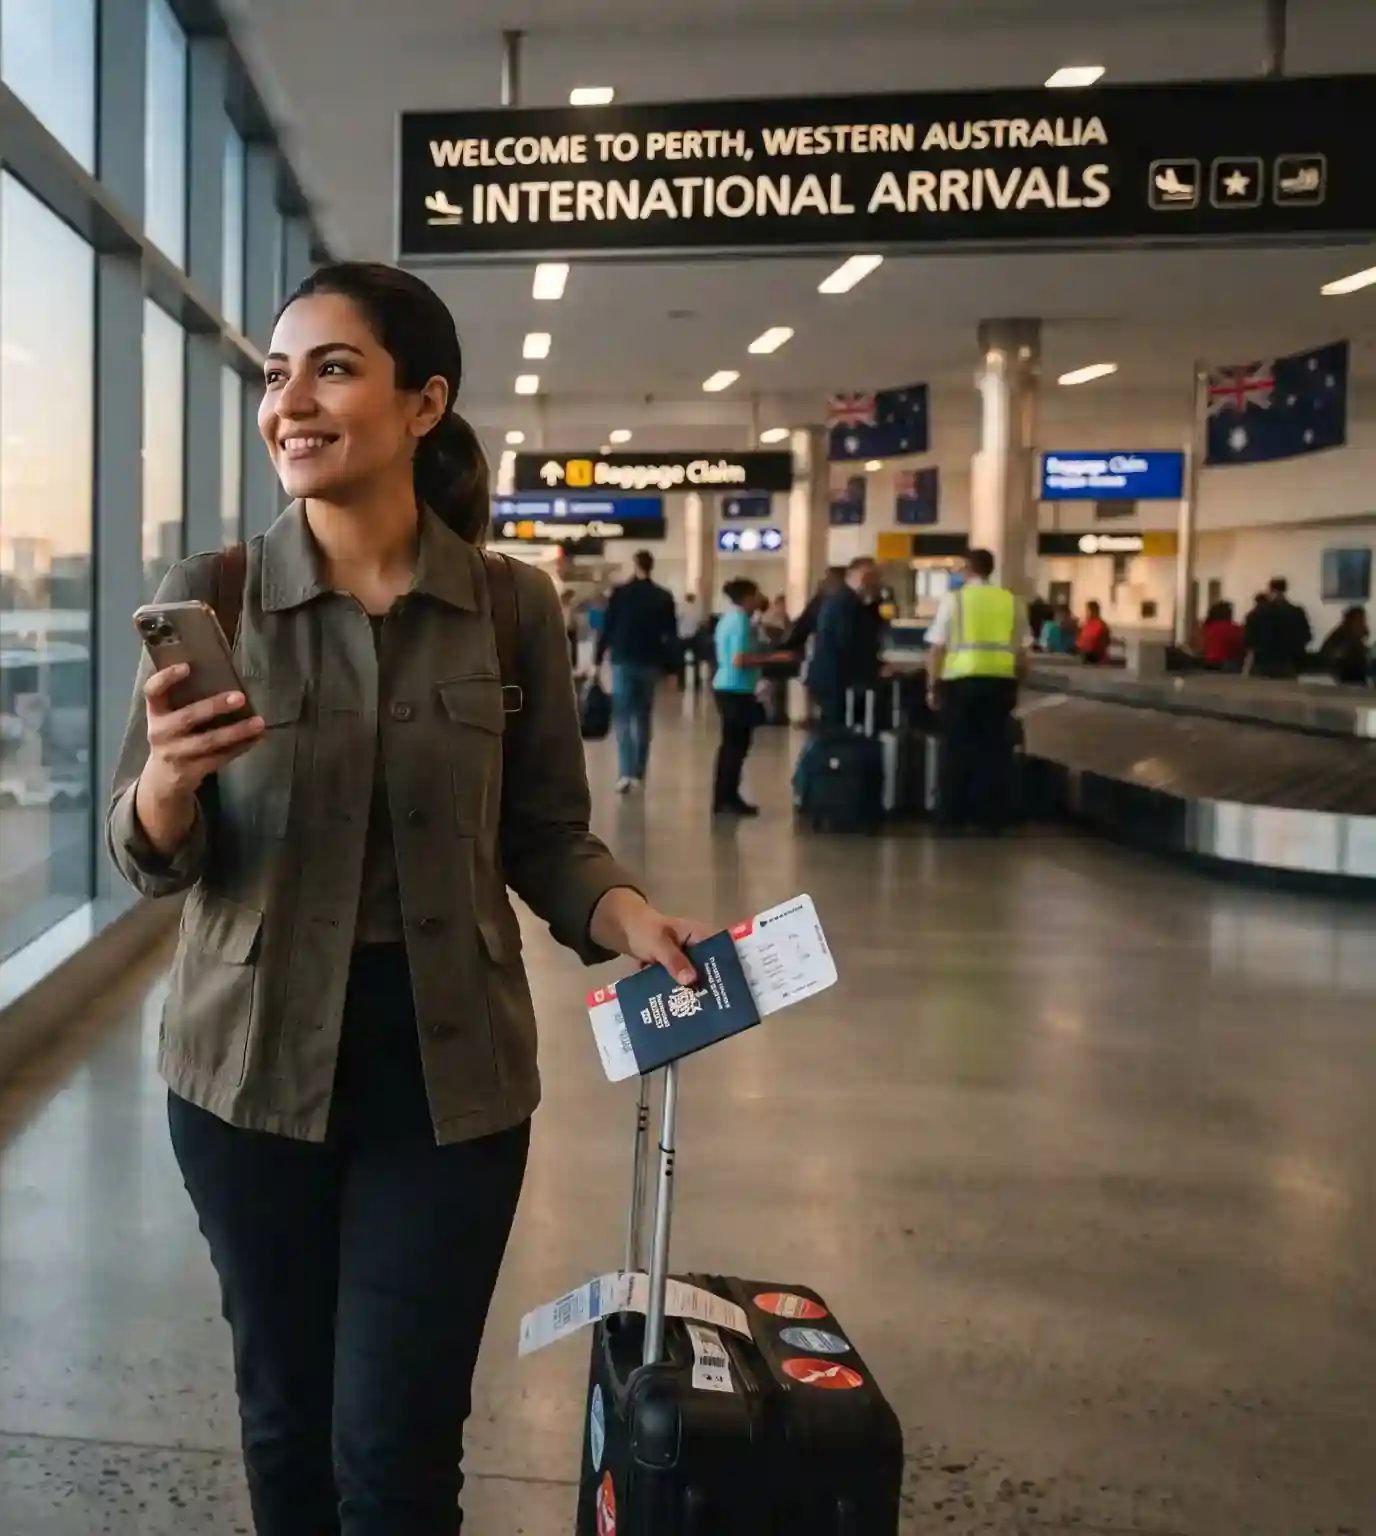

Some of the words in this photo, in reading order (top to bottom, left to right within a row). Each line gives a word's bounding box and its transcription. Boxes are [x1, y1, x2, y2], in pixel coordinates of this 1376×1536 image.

[428, 133, 588, 168] WELCOME
[594, 131, 640, 163] TO
[645, 128, 755, 162] PERTH,
[761, 122, 916, 156] WESTERN
[921, 115, 1109, 151] AUSTRALIA
[471, 172, 856, 225] INTERNATIONAL
[866, 163, 1111, 214] ARRIVALS
